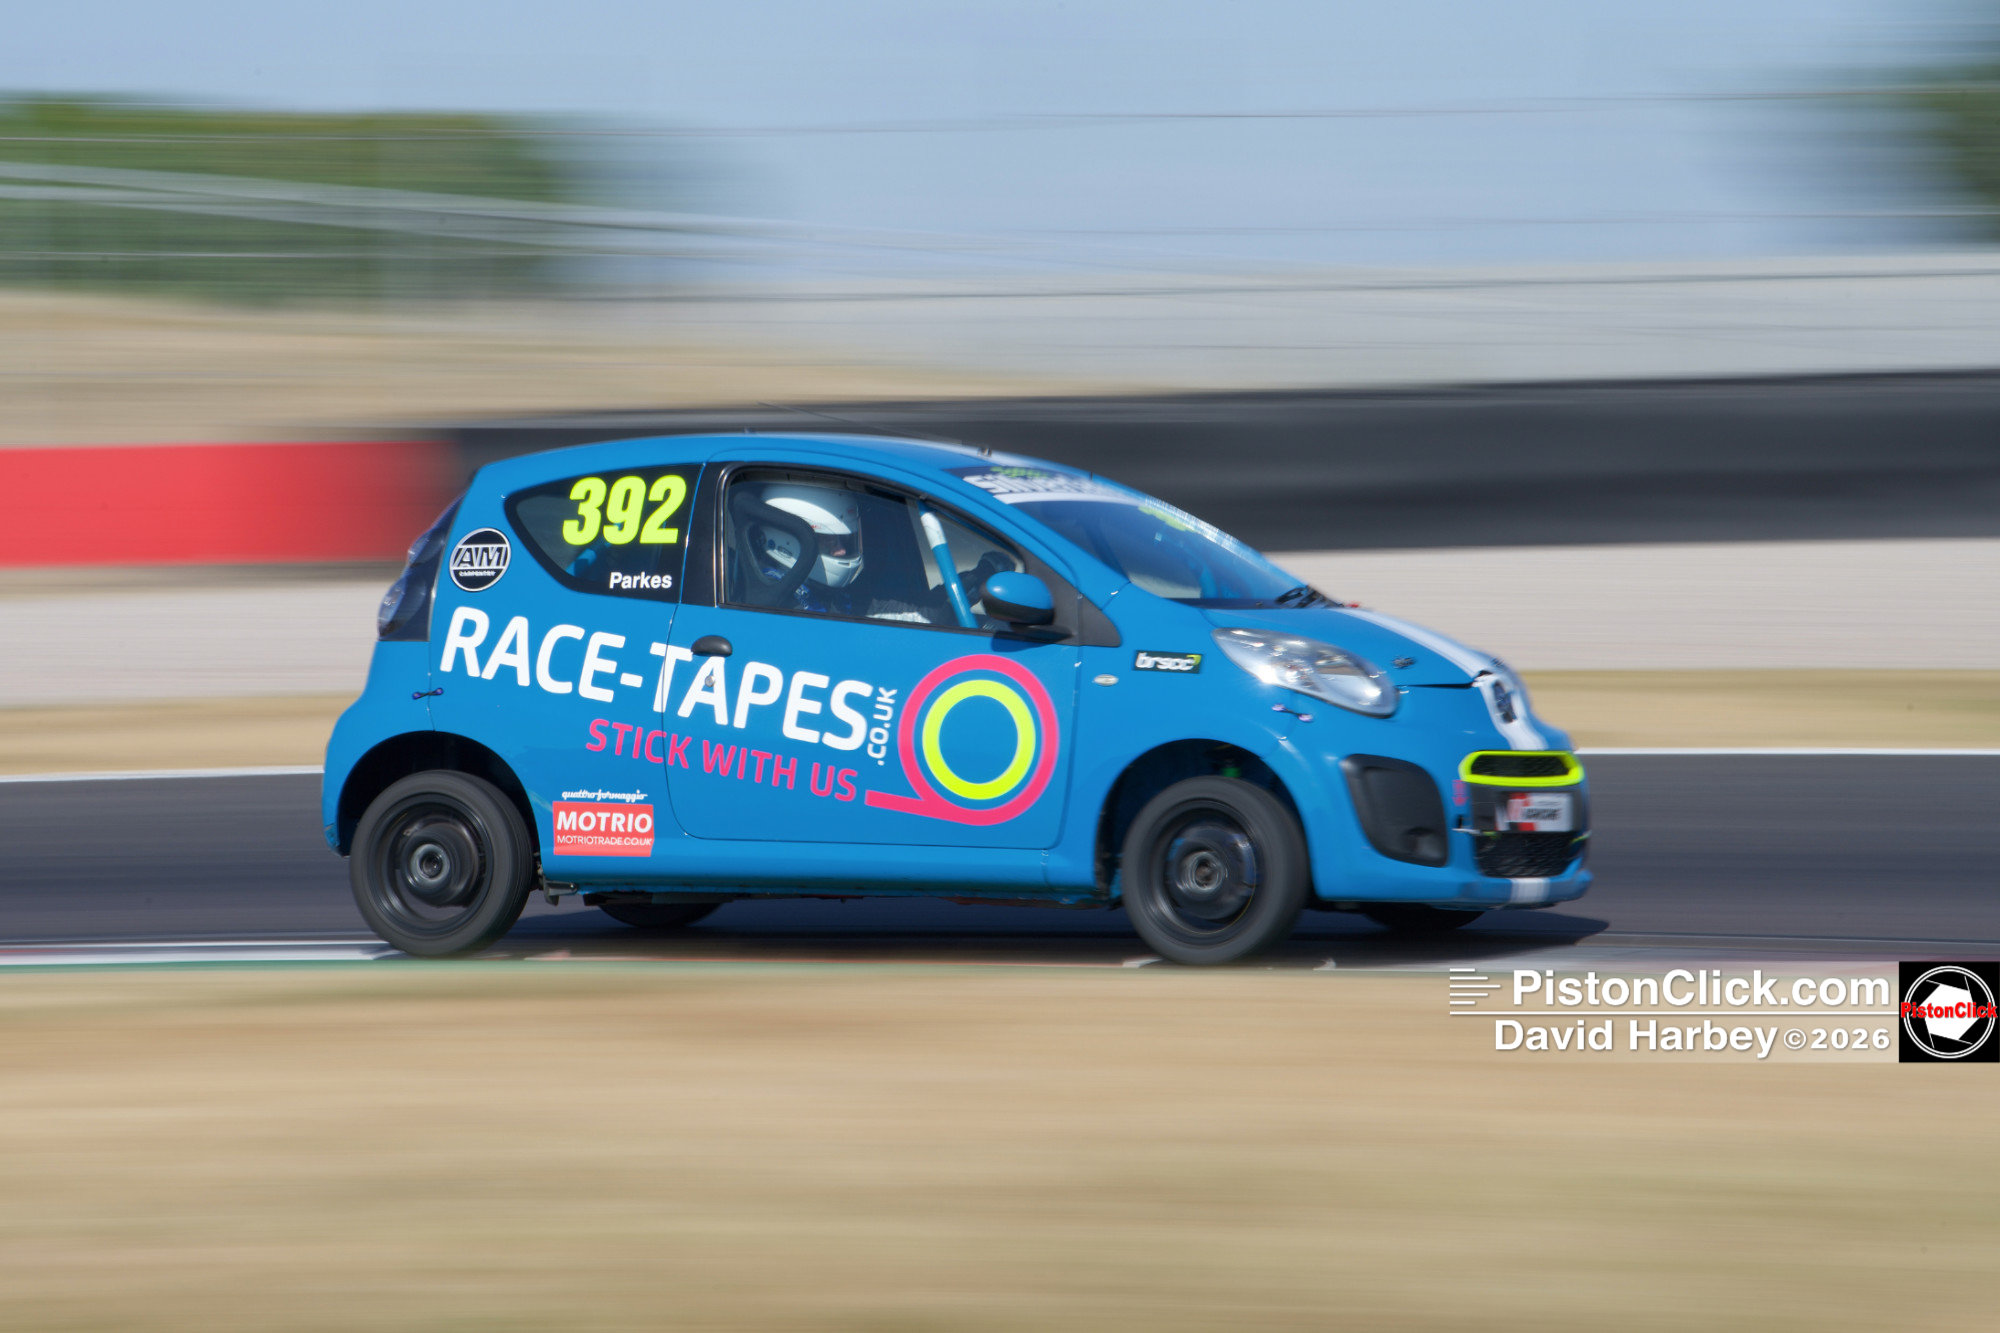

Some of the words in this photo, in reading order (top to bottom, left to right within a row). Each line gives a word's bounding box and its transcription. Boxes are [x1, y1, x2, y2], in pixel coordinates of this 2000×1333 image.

[562, 475, 687, 546] 392
[453, 545, 507, 569] AM
[609, 571, 673, 589] Parkes
[440, 606, 873, 751] RACE-TAPES
[867, 687, 897, 766] .CO.UK
[586, 719, 692, 769] STICK
[702, 739, 798, 790] WITH
[810, 762, 858, 802] US
[557, 811, 653, 834] MOTRIO
[557, 835, 653, 846] MOTRIOTRADE.CO.UK
